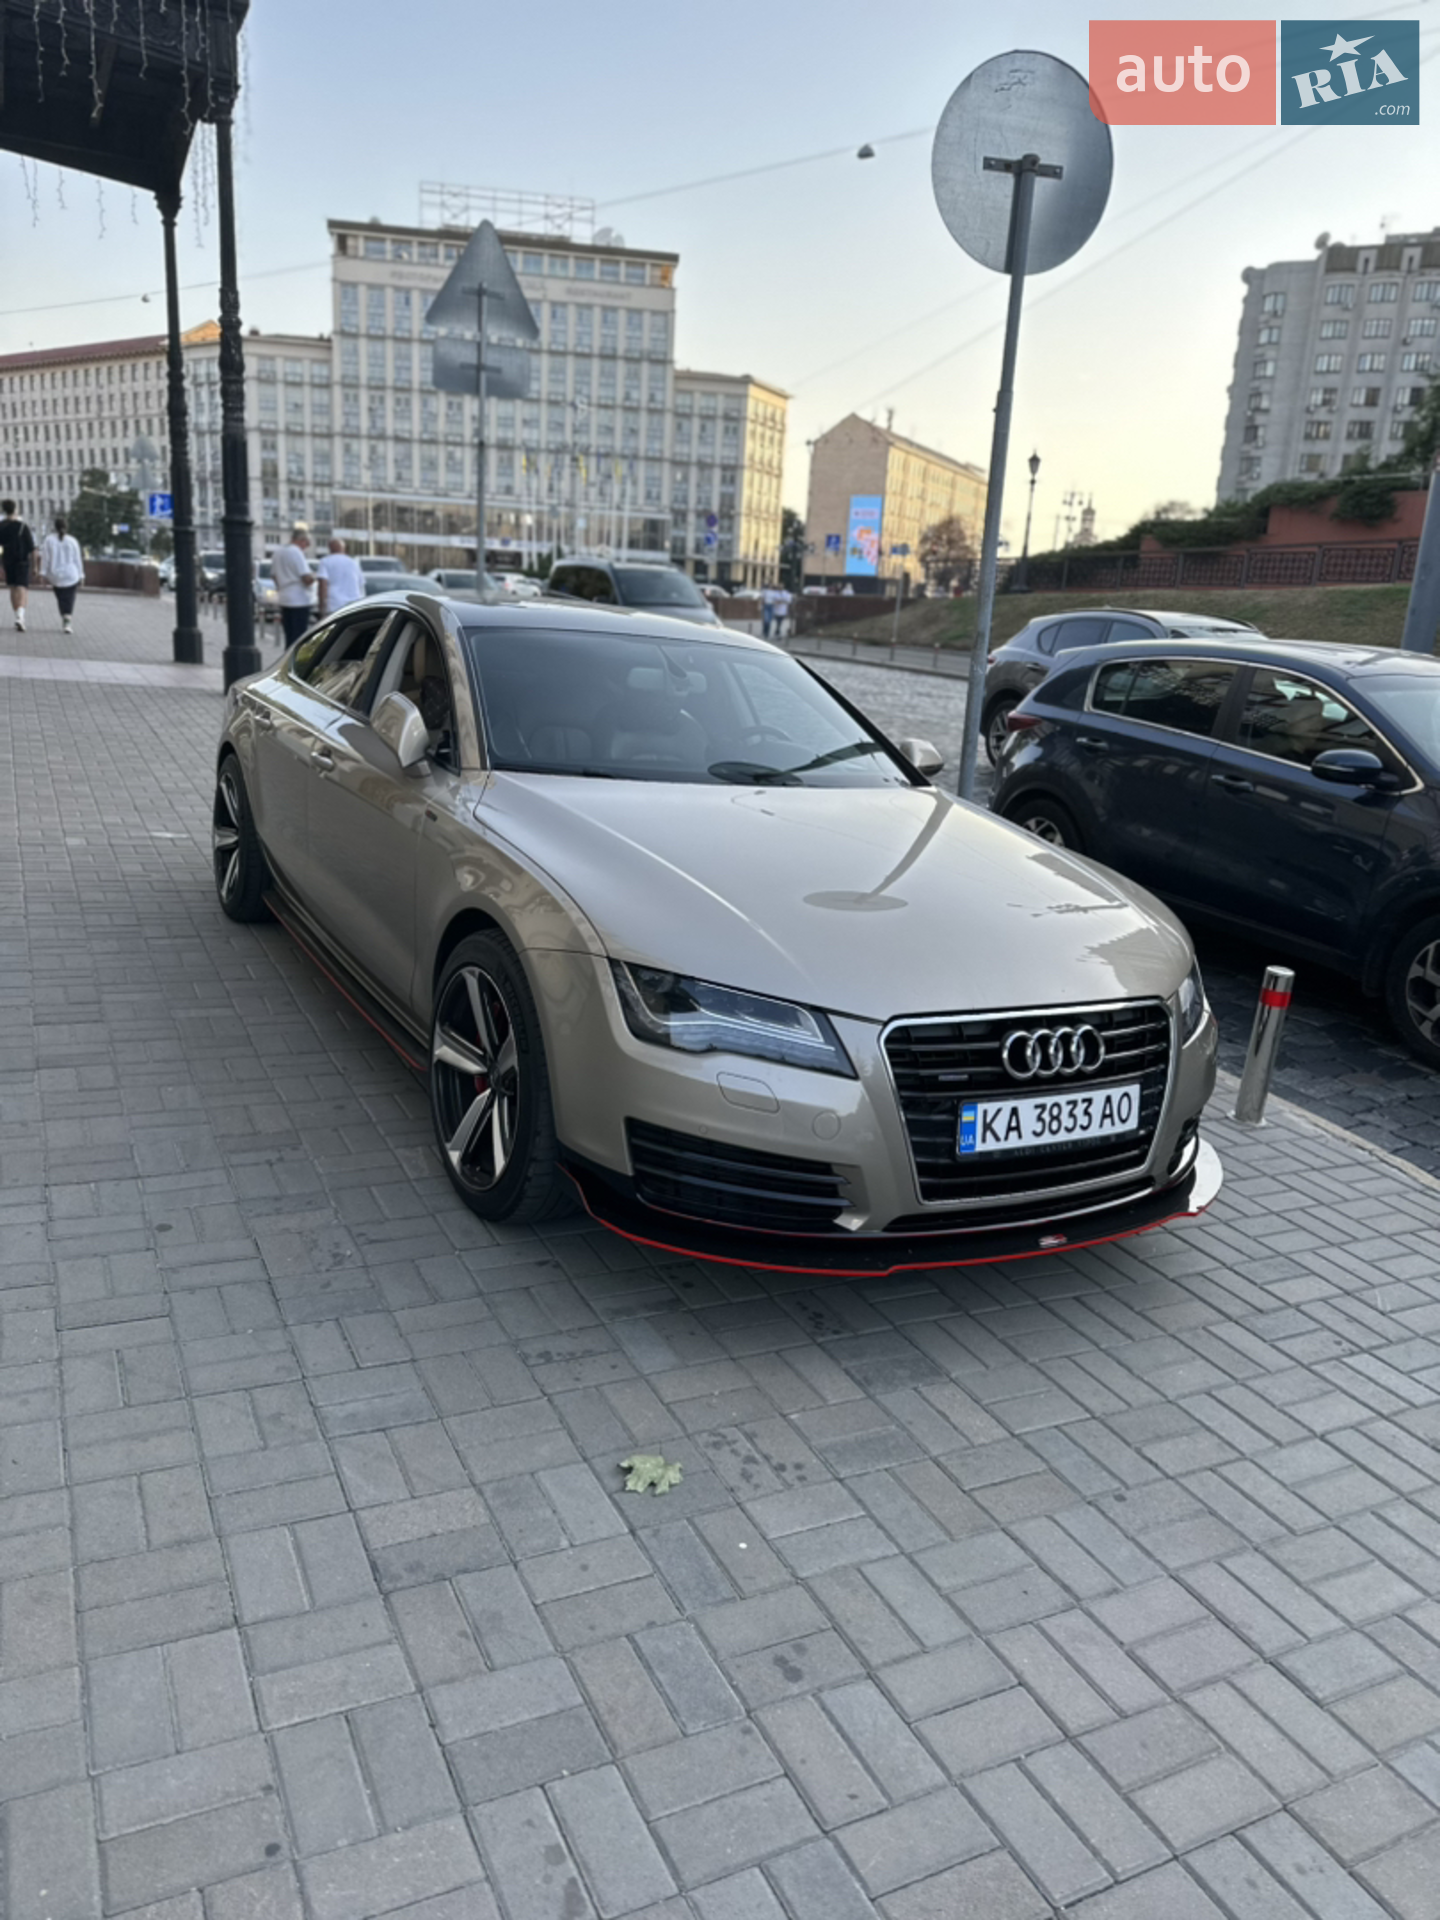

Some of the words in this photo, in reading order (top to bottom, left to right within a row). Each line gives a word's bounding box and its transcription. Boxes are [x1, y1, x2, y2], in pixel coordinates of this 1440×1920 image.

[981, 1106, 1022, 1144] KA
[1032, 1098, 1093, 1137] 3833
[1099, 1091, 1133, 1129] AO
